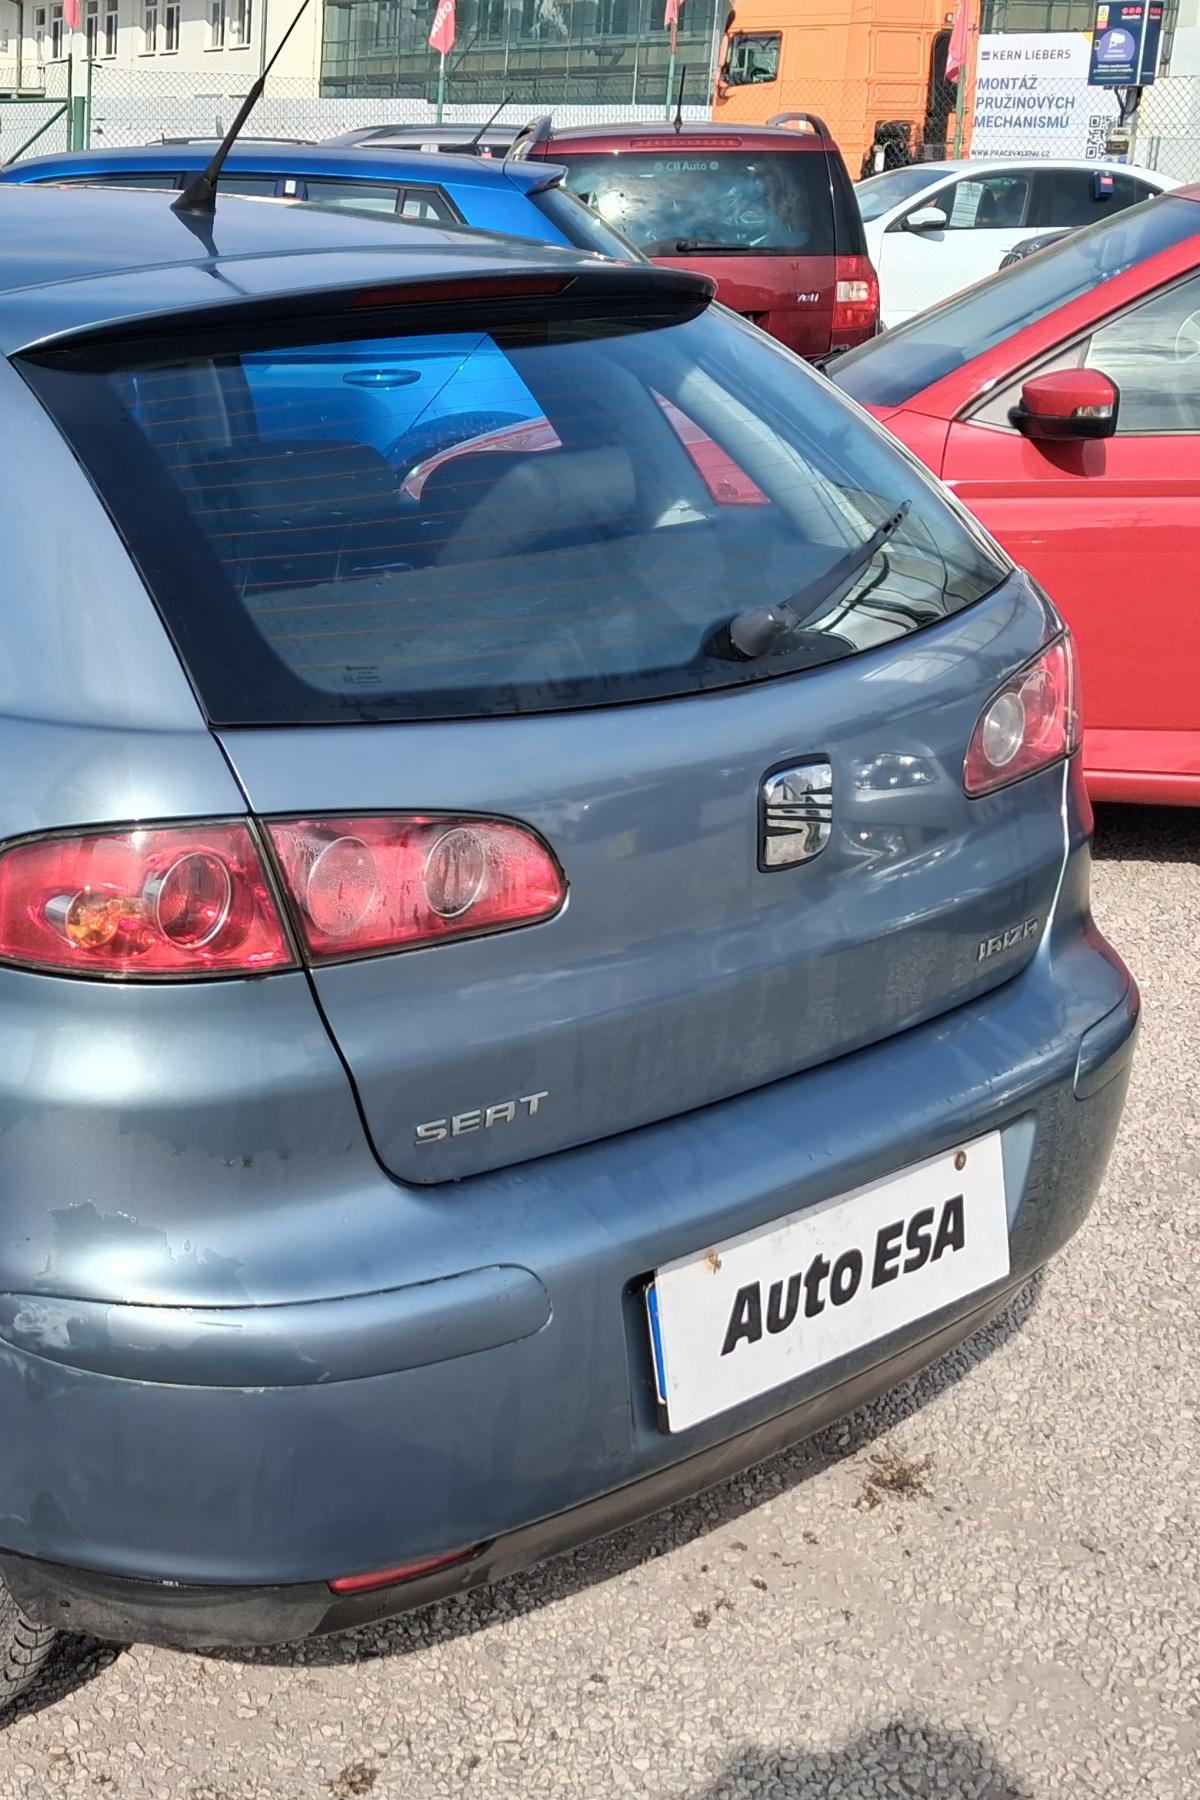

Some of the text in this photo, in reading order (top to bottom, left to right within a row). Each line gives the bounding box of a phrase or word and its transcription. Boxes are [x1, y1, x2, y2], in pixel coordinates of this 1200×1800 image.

[992, 49, 1072, 60] KERN LIEBERS
[977, 73, 1039, 90] MONTÁŽ
[975, 92, 1076, 110] PRUŽINOVÝCH
[415, 1089, 549, 1145] SEAT
[720, 1193, 966, 1358] Auto ESA
